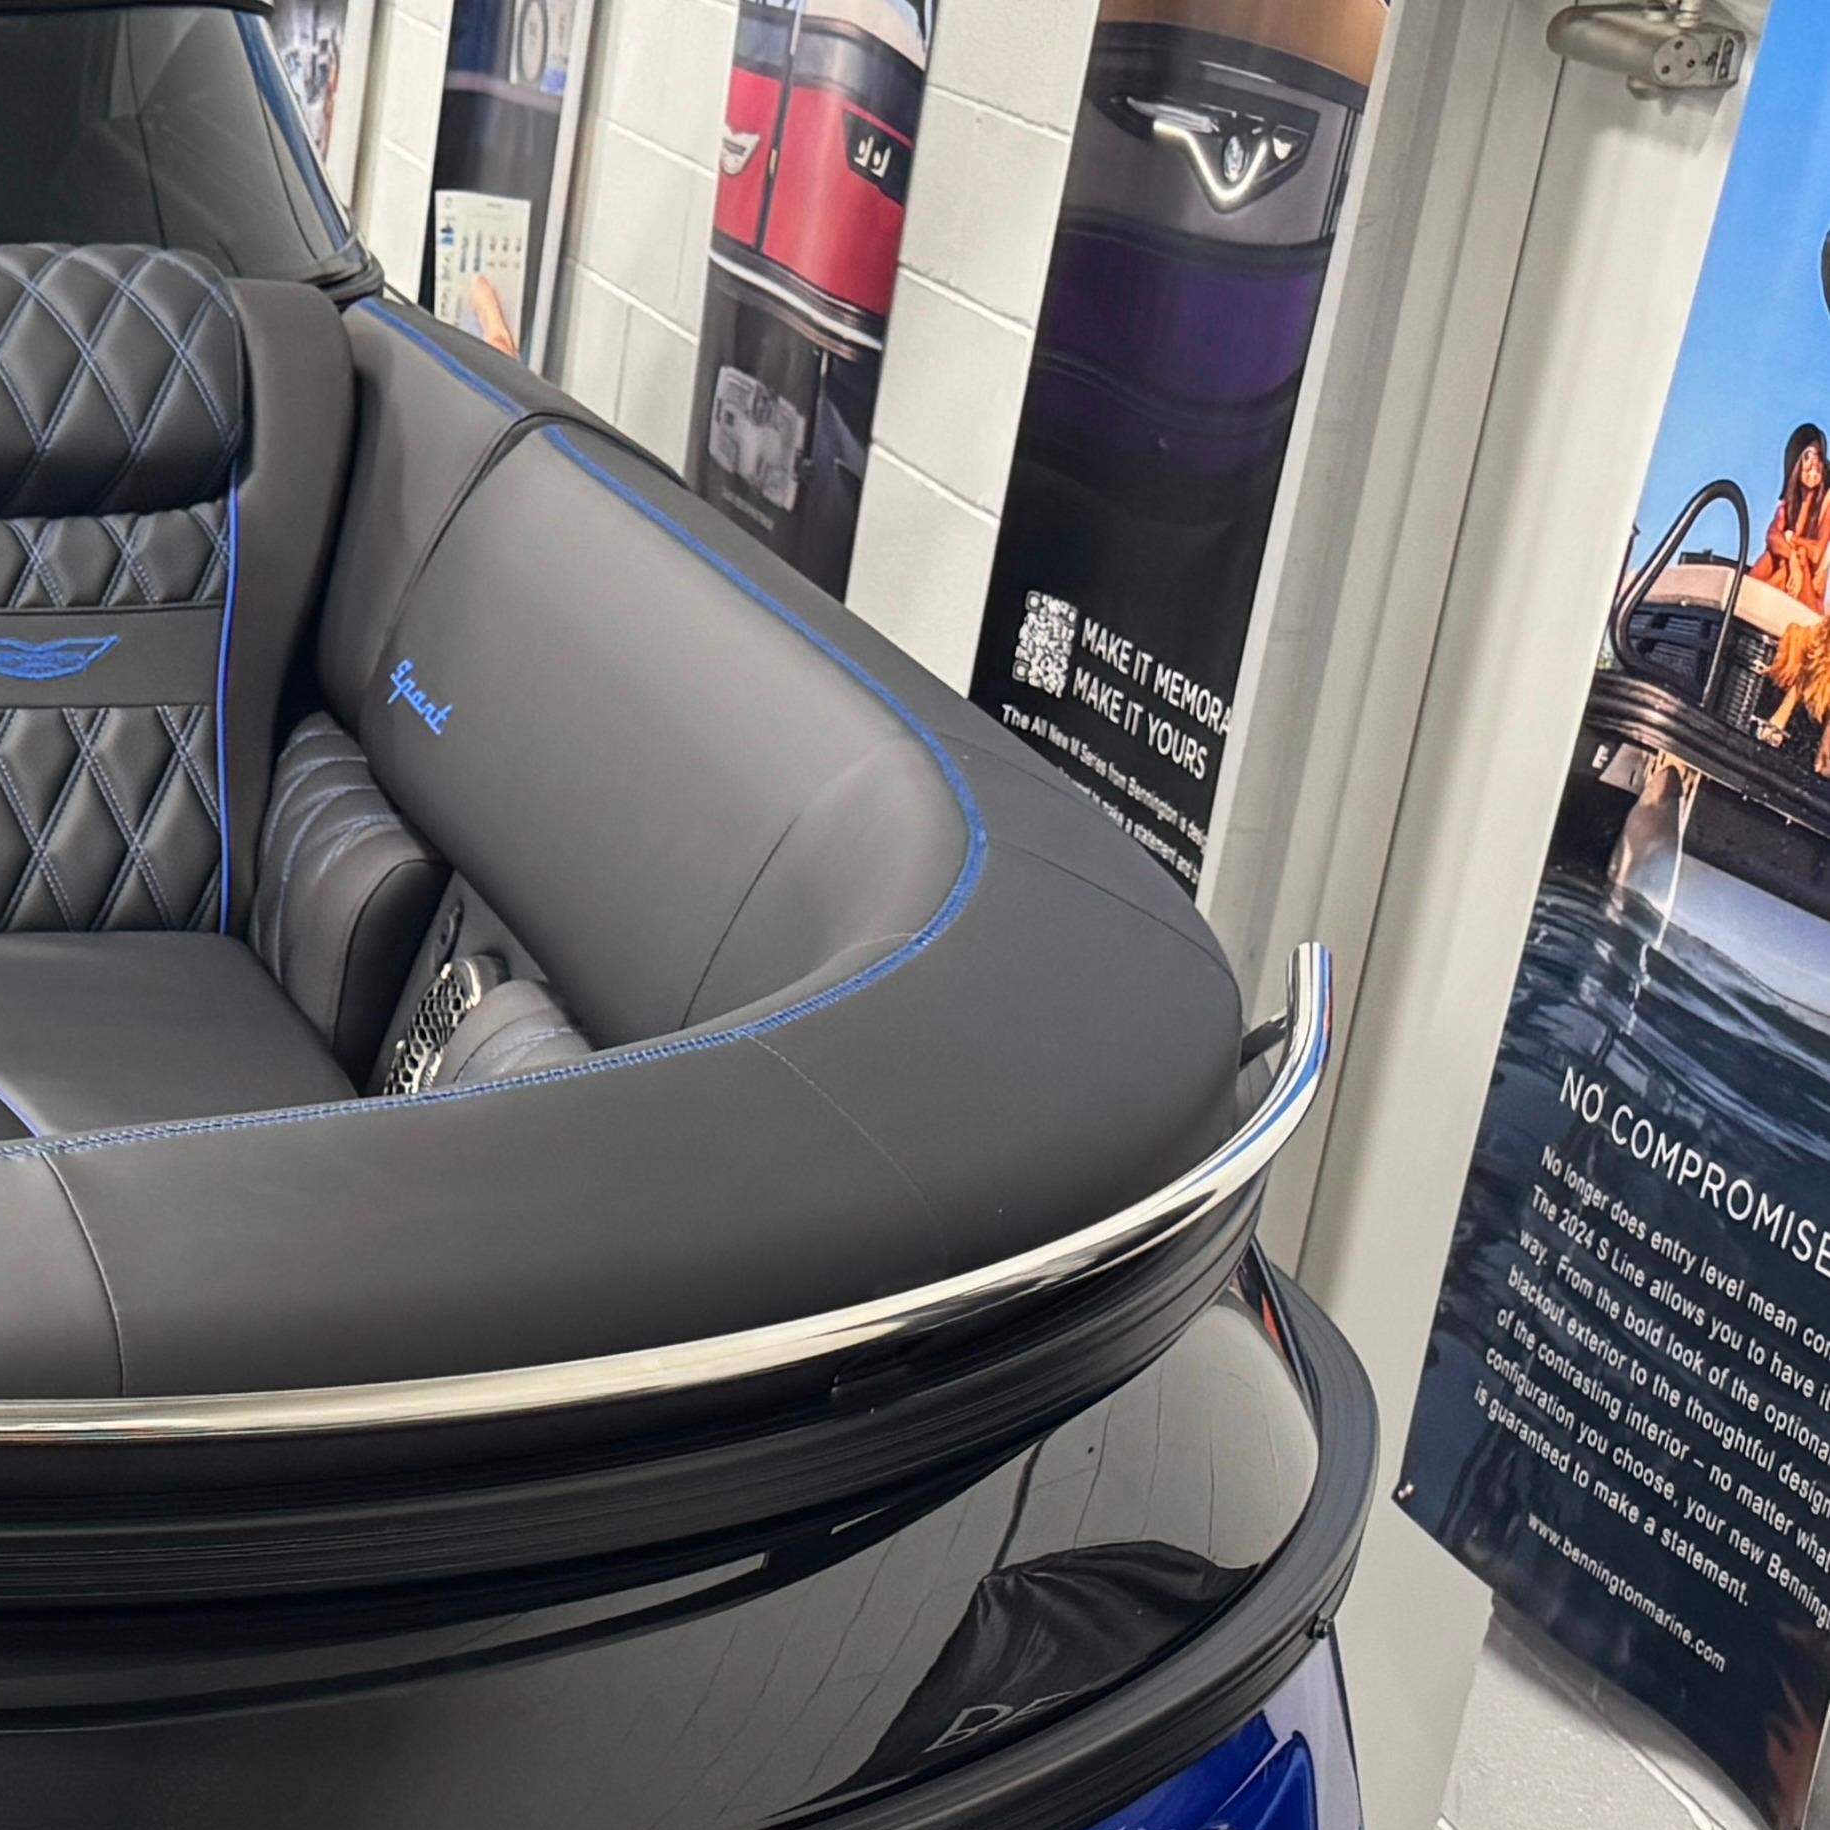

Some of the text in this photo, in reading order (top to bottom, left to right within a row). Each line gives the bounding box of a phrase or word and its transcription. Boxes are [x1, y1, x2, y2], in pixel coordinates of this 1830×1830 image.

[1001, 703, 1030, 731] The
[1030, 715, 1048, 738] All
[1072, 666, 1208, 780] MAKE IT YOURS
[1081, 617, 1134, 675] MAKE
[1133, 650, 1153, 686] IT
[1541, 1145, 1563, 1177] No
[1563, 1162, 1610, 1211] longer
[1610, 1201, 1647, 1241] does
[1651, 1231, 1697, 1275] entry
[1699, 1256, 1745, 1302] level
[1747, 1291, 1798, 1337] mean
[1560, 1066, 1830, 1280] NO COMPROMISE
[1508, 1264, 1830, 1519] blackout exterior to the thoughtful design
[1520, 1229, 1548, 1266] way.
[1556, 1255, 1594, 1299] From
[1596, 1286, 1620, 1319] the
[1624, 1305, 1664, 1349] bold
[1666, 1333, 1705, 1376] look
[1708, 1366, 1730, 1391] of
[1730, 1377, 1760, 1412] the
[1532, 1184, 1558, 1222] The
[1558, 1208, 1595, 1249] 2024
[1596, 1237, 1610, 1261] S
[1610, 1248, 1645, 1288] Line
[1649, 1279, 1706, 1327] allows
[1708, 1316, 1743, 1351] you
[1747, 1337, 1765, 1365] to
[1769, 1352, 1814, 1397] have
[1474, 1379, 1749, 1607] is guaranteed to make a statement.
[1486, 1347, 1575, 1431] configuration
[1576, 1421, 1609, 1456] you
[1612, 1447, 1678, 1508] choose,
[1683, 1496, 1727, 1536] your
[1728, 1528, 1765, 1565] new
[1497, 1308, 1515, 1331] of
[1513, 1318, 1536, 1351] the
[1538, 1343, 1622, 1421] contrasting
[1625, 1402, 1691, 1461] interior
[1708, 1465, 1732, 1492] no
[1736, 1484, 1794, 1536] matter
[1796, 1527, 1830, 1574] what
[1527, 1511, 1727, 1673] www.benningtonmarine.com
